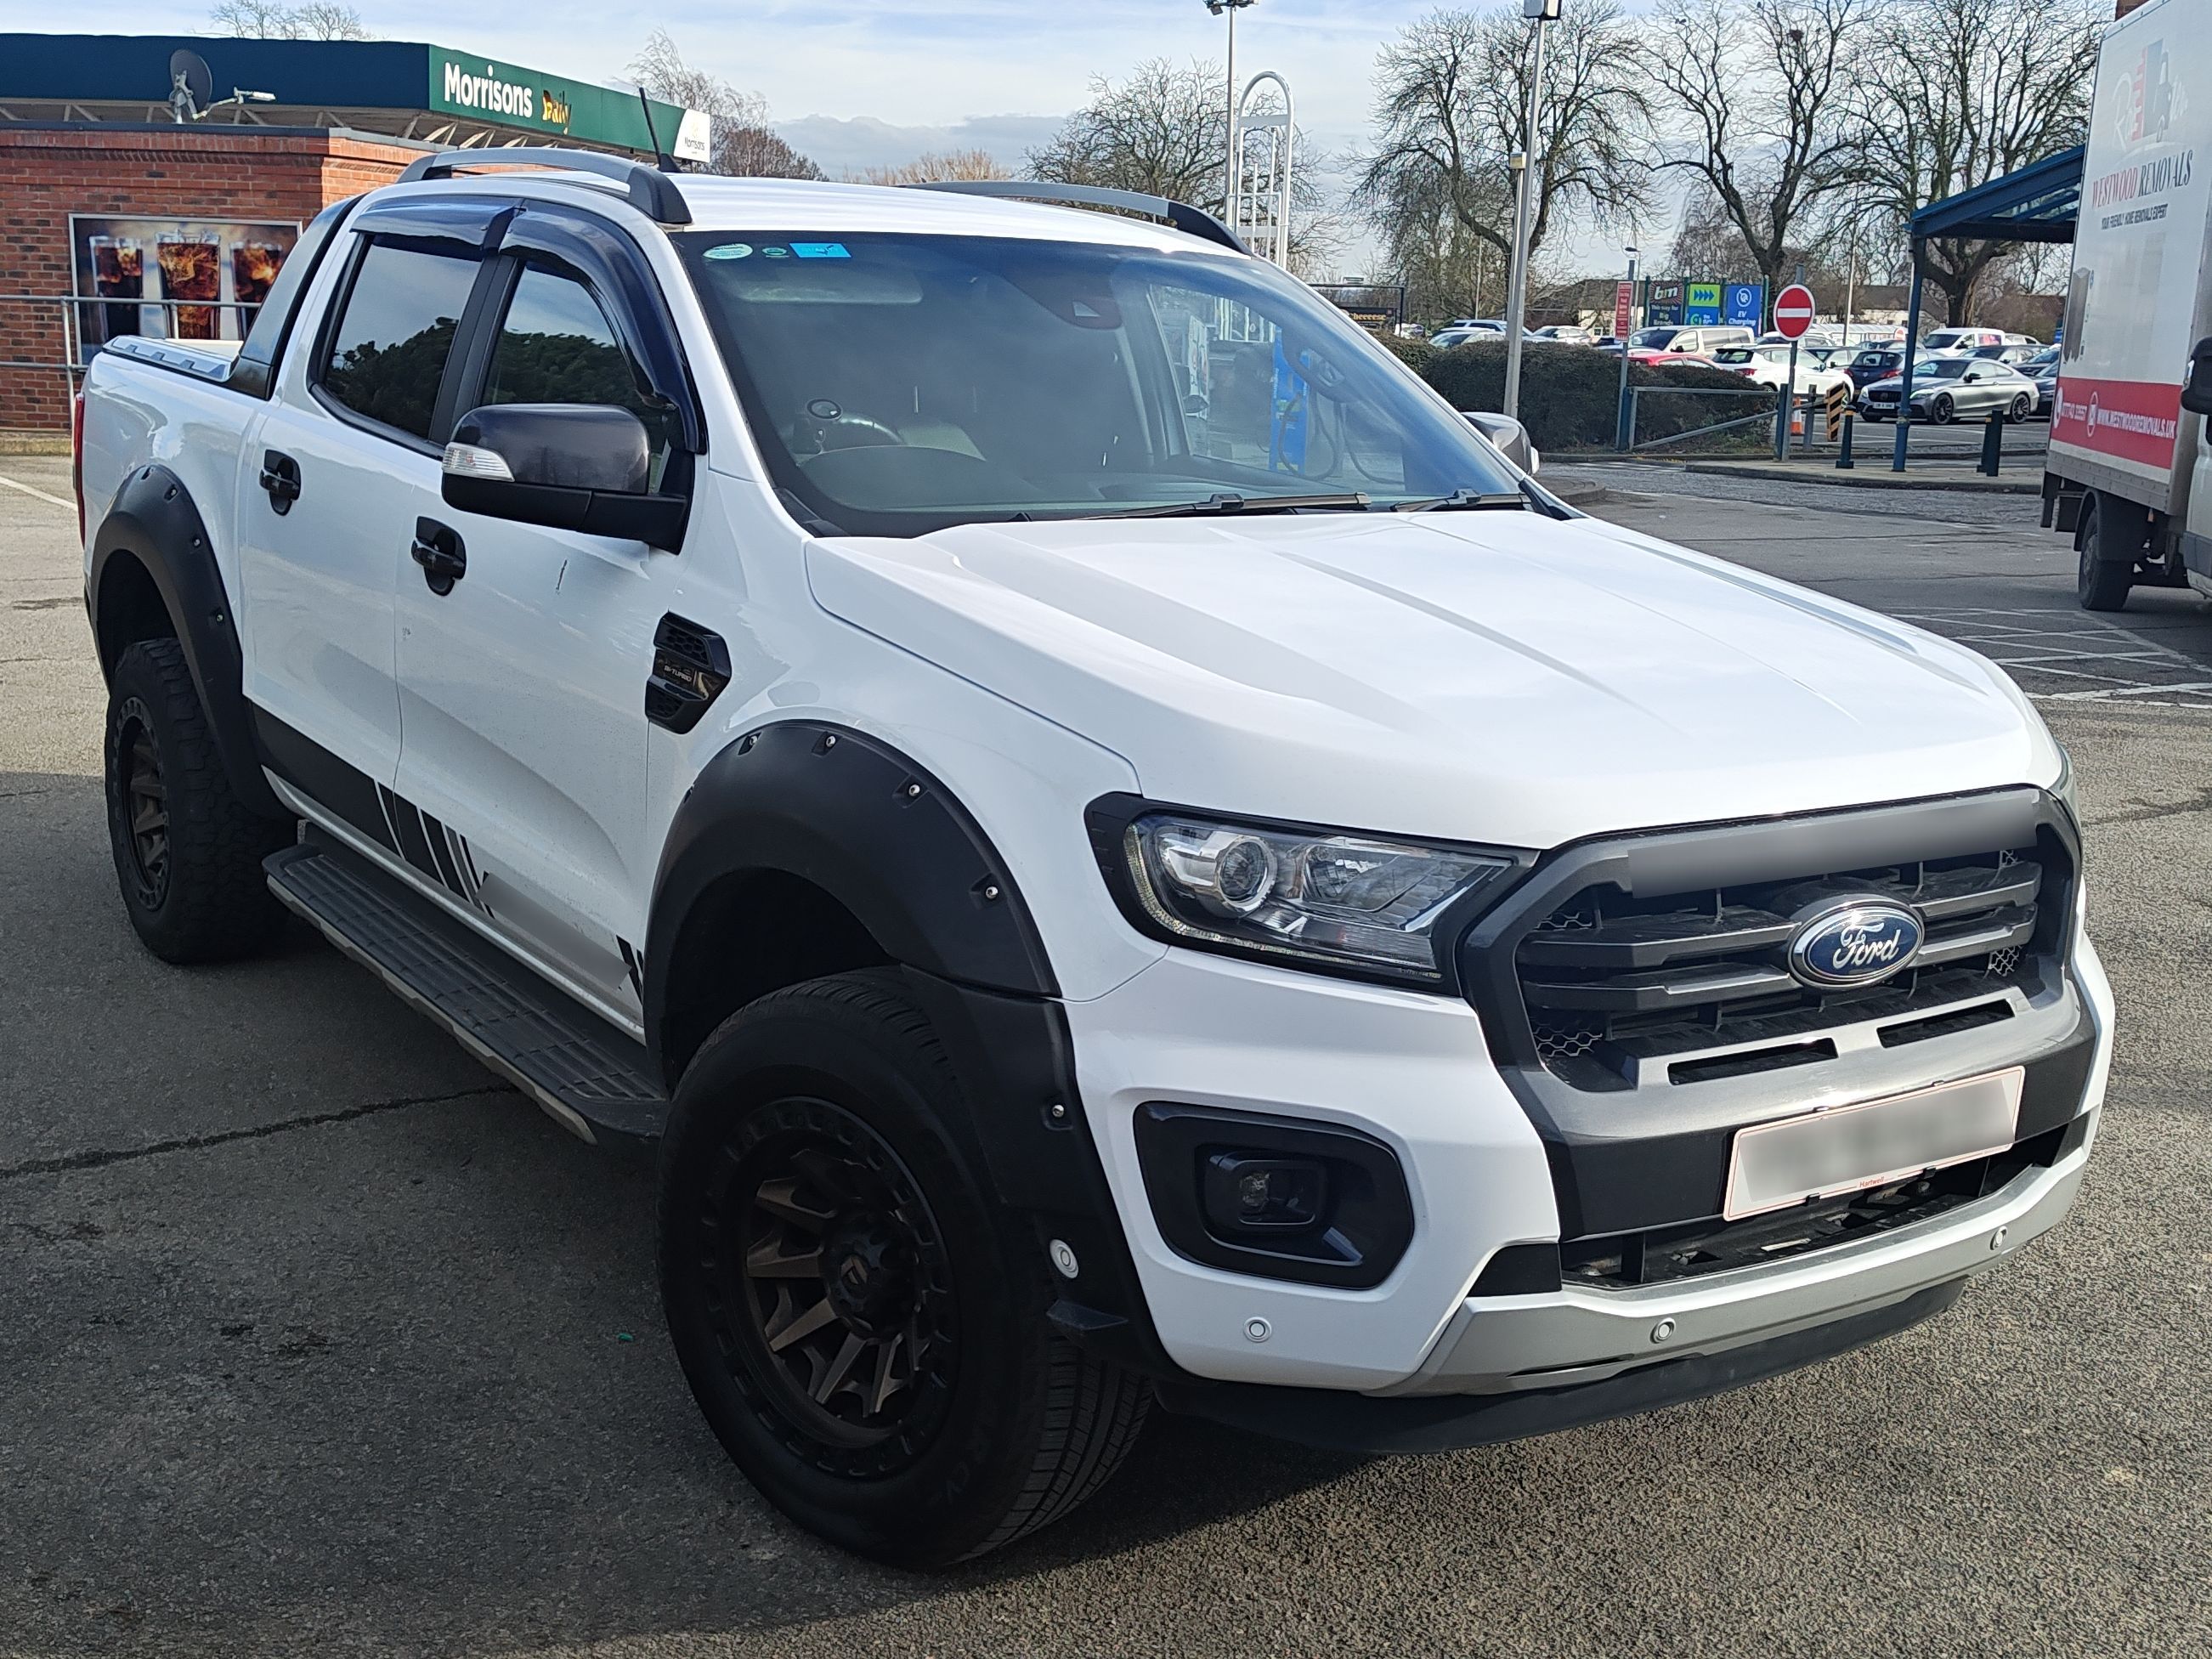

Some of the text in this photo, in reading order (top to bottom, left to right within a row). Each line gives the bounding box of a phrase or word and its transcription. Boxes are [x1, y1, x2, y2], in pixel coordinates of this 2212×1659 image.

[444, 62, 572, 135] Morrisons Daily
[2091, 150, 2193, 209] WESTWOOD REMOVALS
[1728, 317, 1757, 326] Charging
[1832, 922, 1901, 969] Ford
[1859, 1175, 1885, 1188] Hartwell
